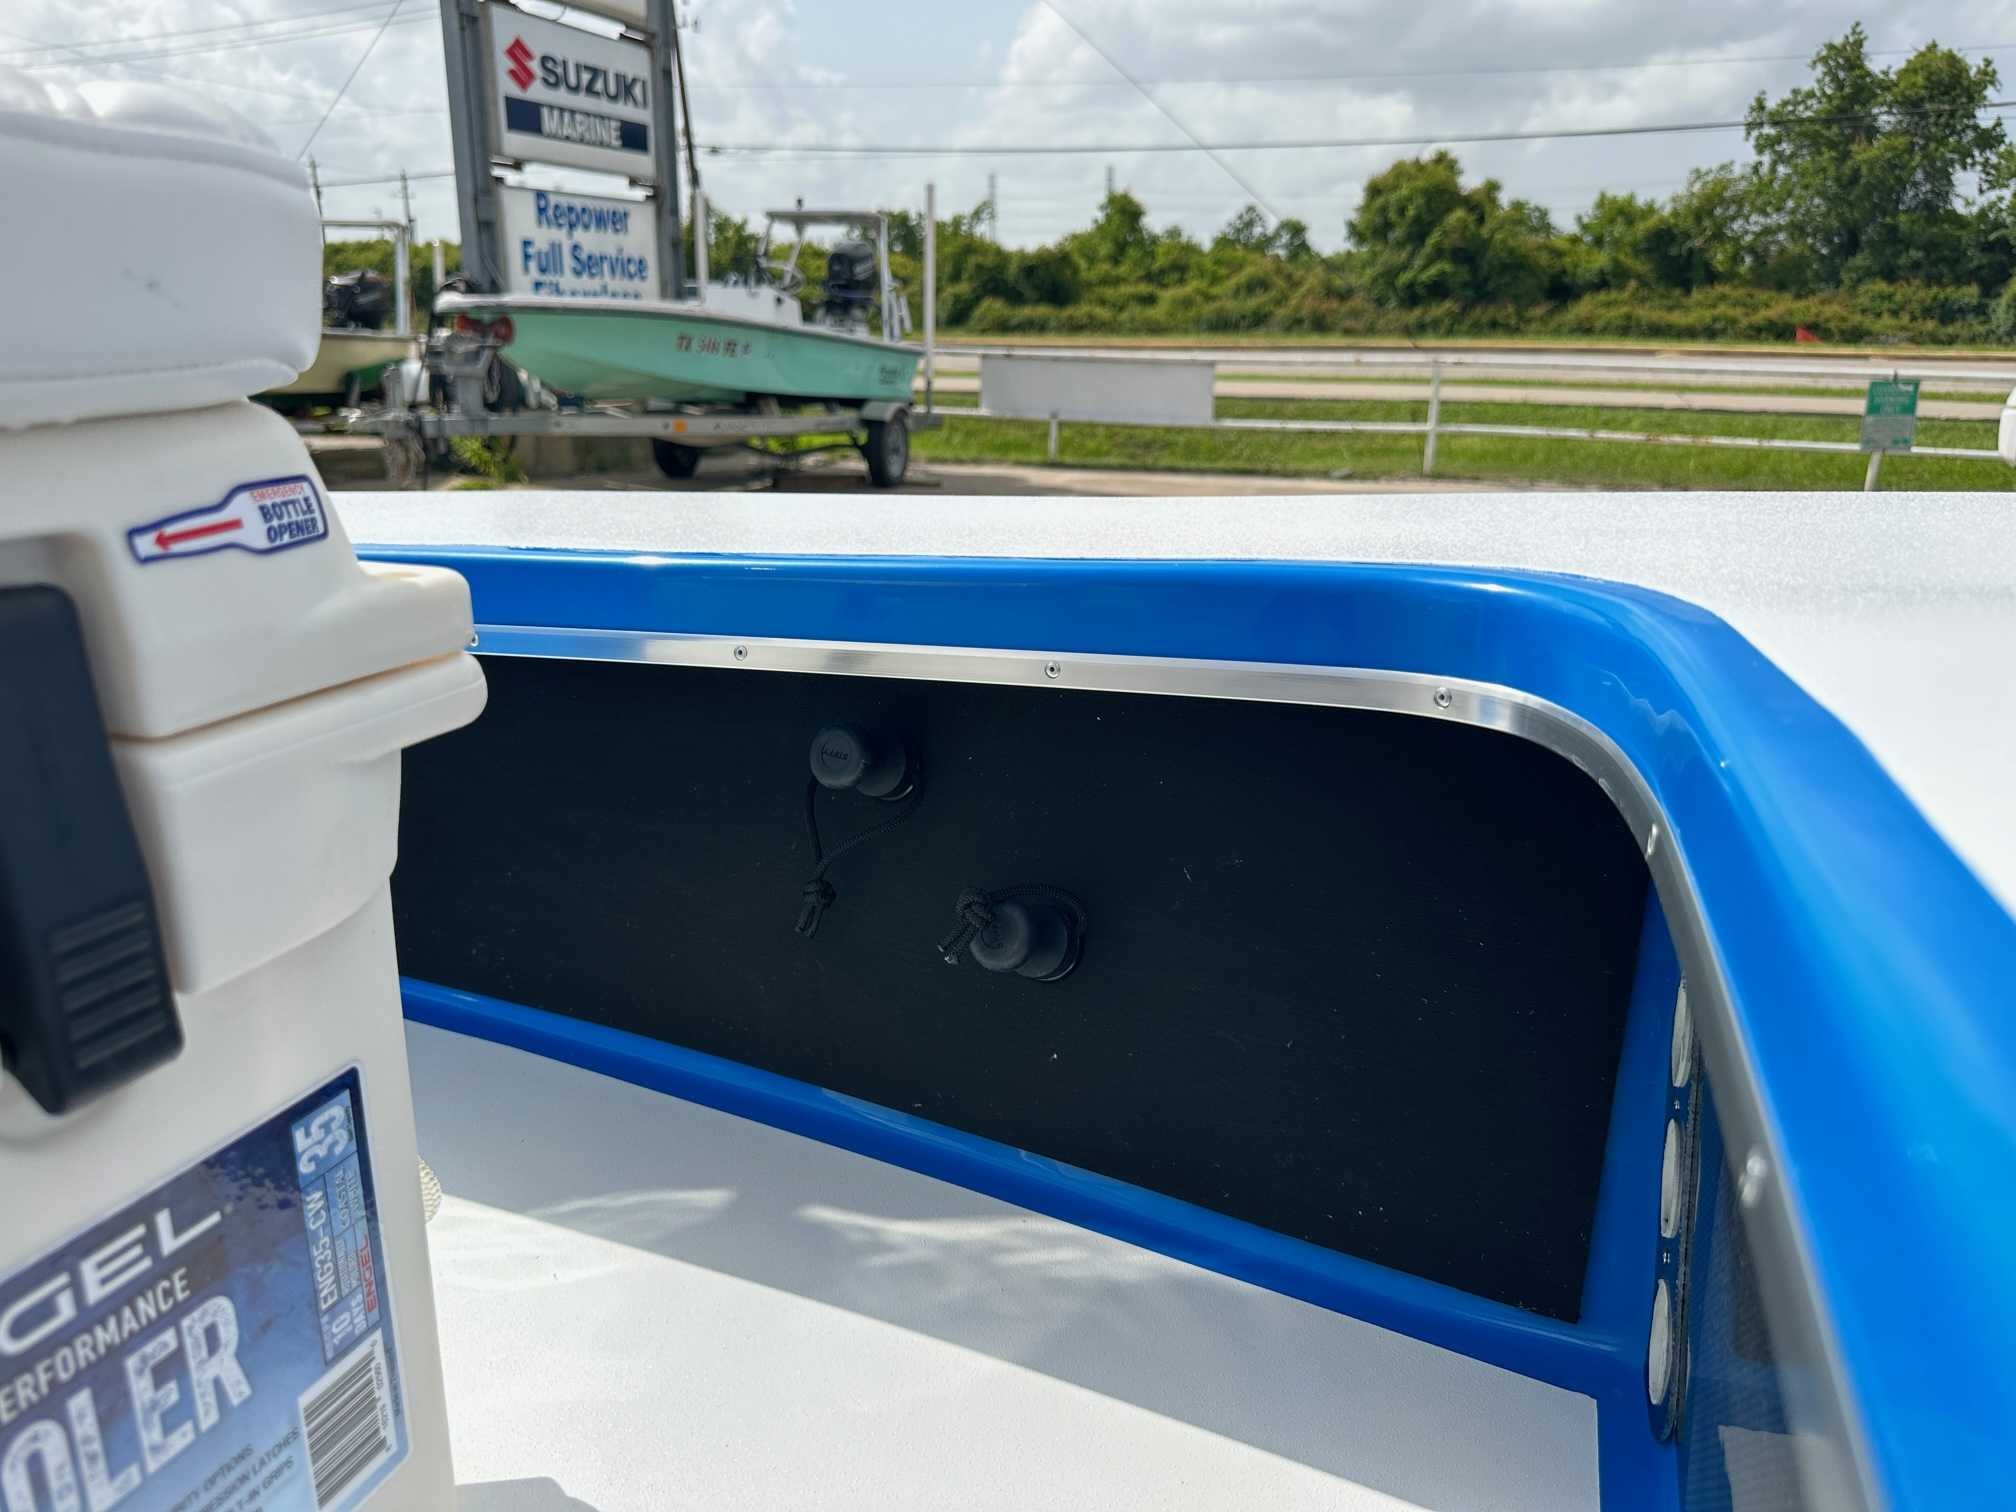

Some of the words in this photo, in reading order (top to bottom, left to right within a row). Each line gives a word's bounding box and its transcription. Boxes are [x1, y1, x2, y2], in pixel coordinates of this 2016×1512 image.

[540, 55, 648, 109] SUZUKI
[541, 105, 624, 148] MARINE
[535, 191, 632, 238] Repower
[521, 239, 564, 277] Full
[571, 243, 648, 283] Service
[258, 496, 316, 524] BOTTLE
[266, 517, 320, 544] OPENER
[295, 1104, 349, 1174] 35
[305, 1190, 338, 1311] ENG35-CW
[360, 1234, 377, 1313] ENGEL
[332, 1311, 354, 1345] 10
[351, 1293, 367, 1335] DAYS
[252, 1425, 300, 1476] LATCHES
